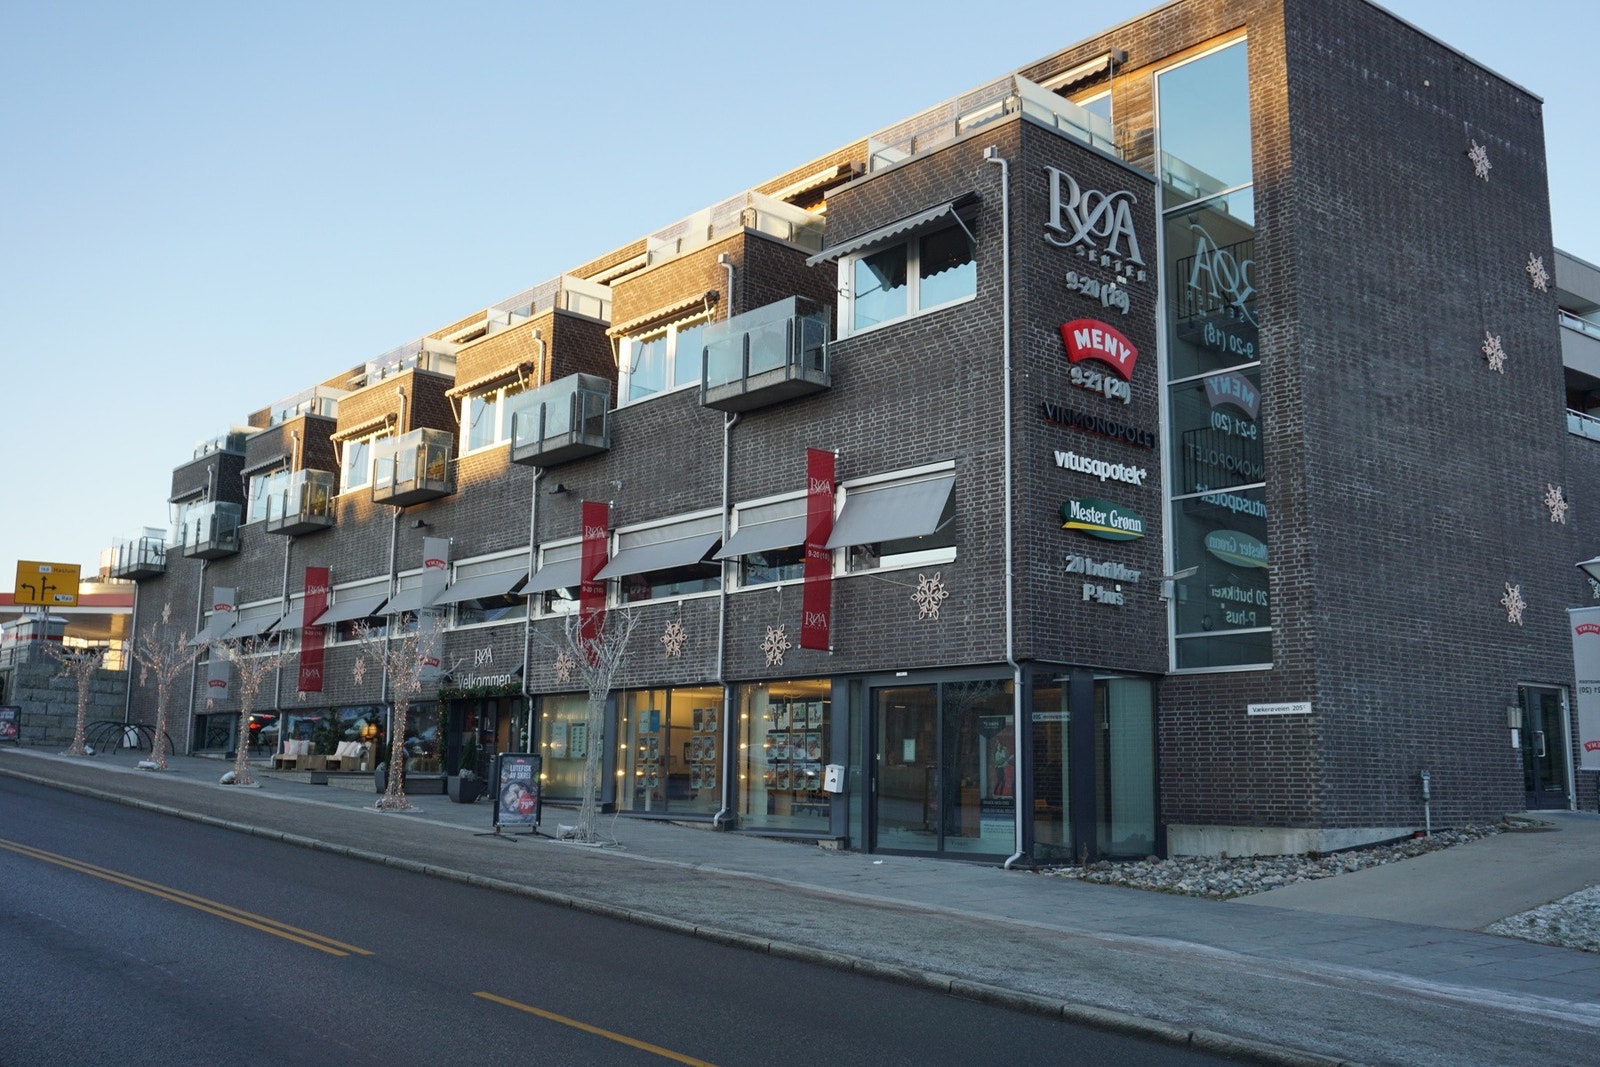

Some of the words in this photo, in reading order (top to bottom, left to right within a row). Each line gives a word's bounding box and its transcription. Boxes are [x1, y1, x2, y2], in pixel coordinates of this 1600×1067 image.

[1043, 165, 1146, 267] RØA
[1073, 328, 1131, 364] MENY
[1042, 401, 1155, 449] VINMONOPOLET
[1070, 500, 1106, 525] Mester
[1110, 509, 1142, 532] Grønn
[458, 672, 511, 690] Velkommen
